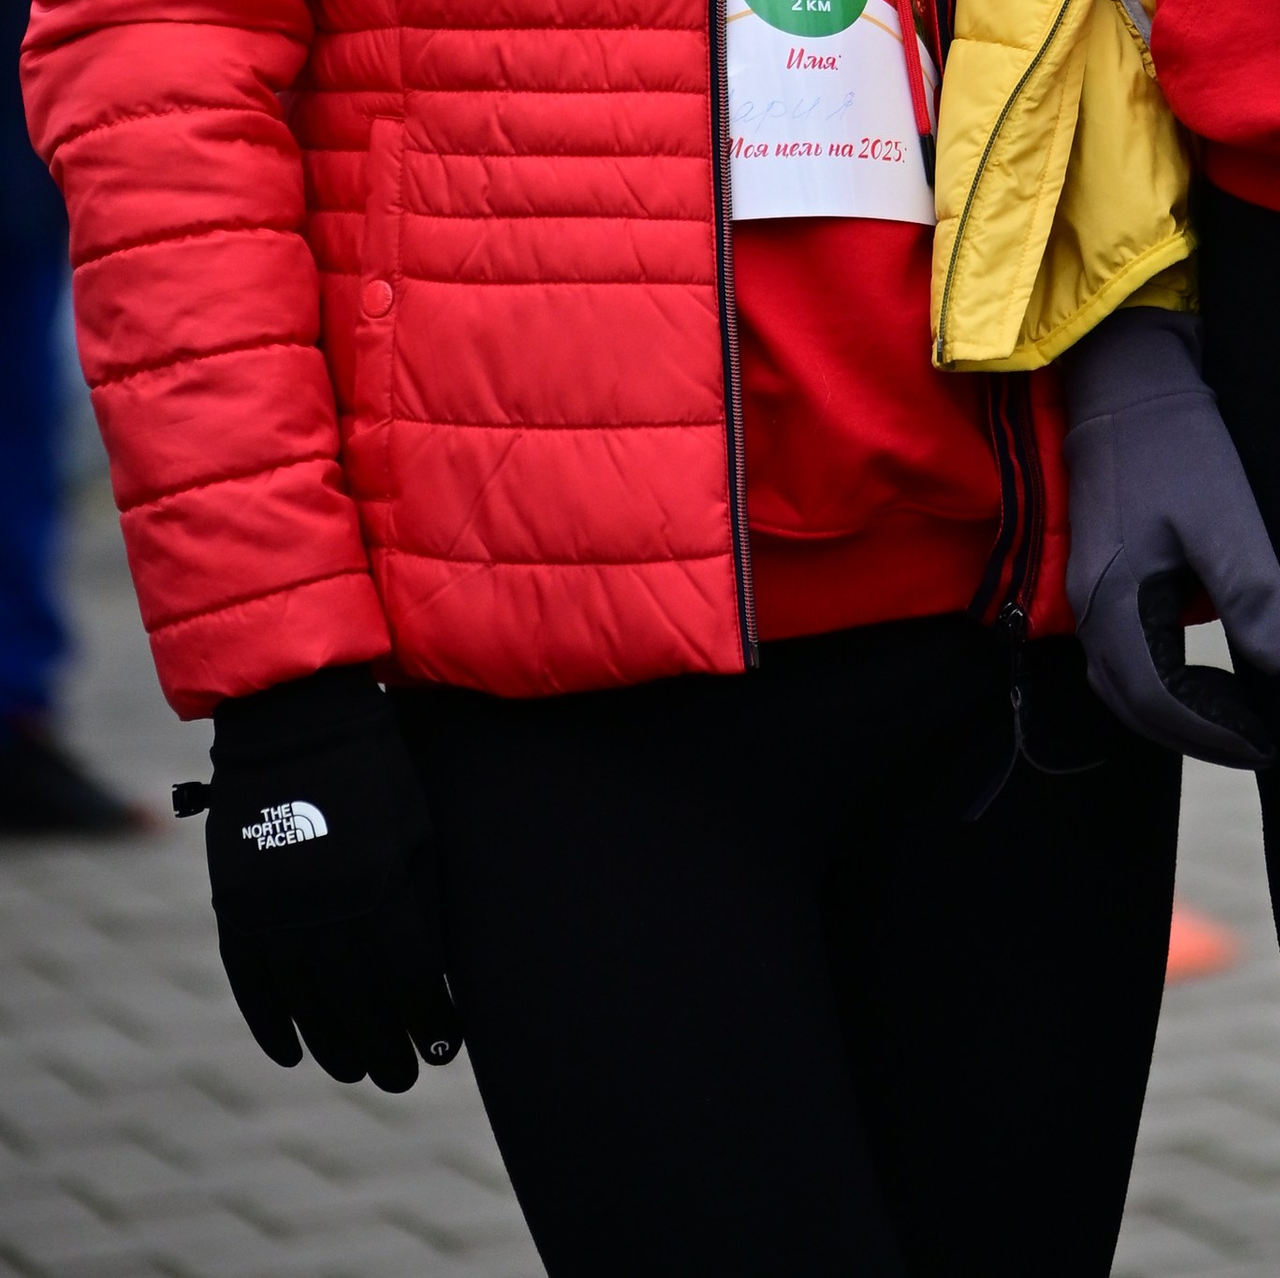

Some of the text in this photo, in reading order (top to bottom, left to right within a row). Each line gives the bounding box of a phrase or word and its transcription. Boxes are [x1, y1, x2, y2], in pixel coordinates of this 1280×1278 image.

[806, 0, 831, 12] км
[786, 48, 841, 71] Имя:
[728, 89, 855, 133] ария
[775, 141, 823, 158] цель
[828, 141, 854, 158] на
[260, 802, 292, 822] THE
[242, 817, 295, 839] NORTH
[257, 830, 297, 851] FACE
